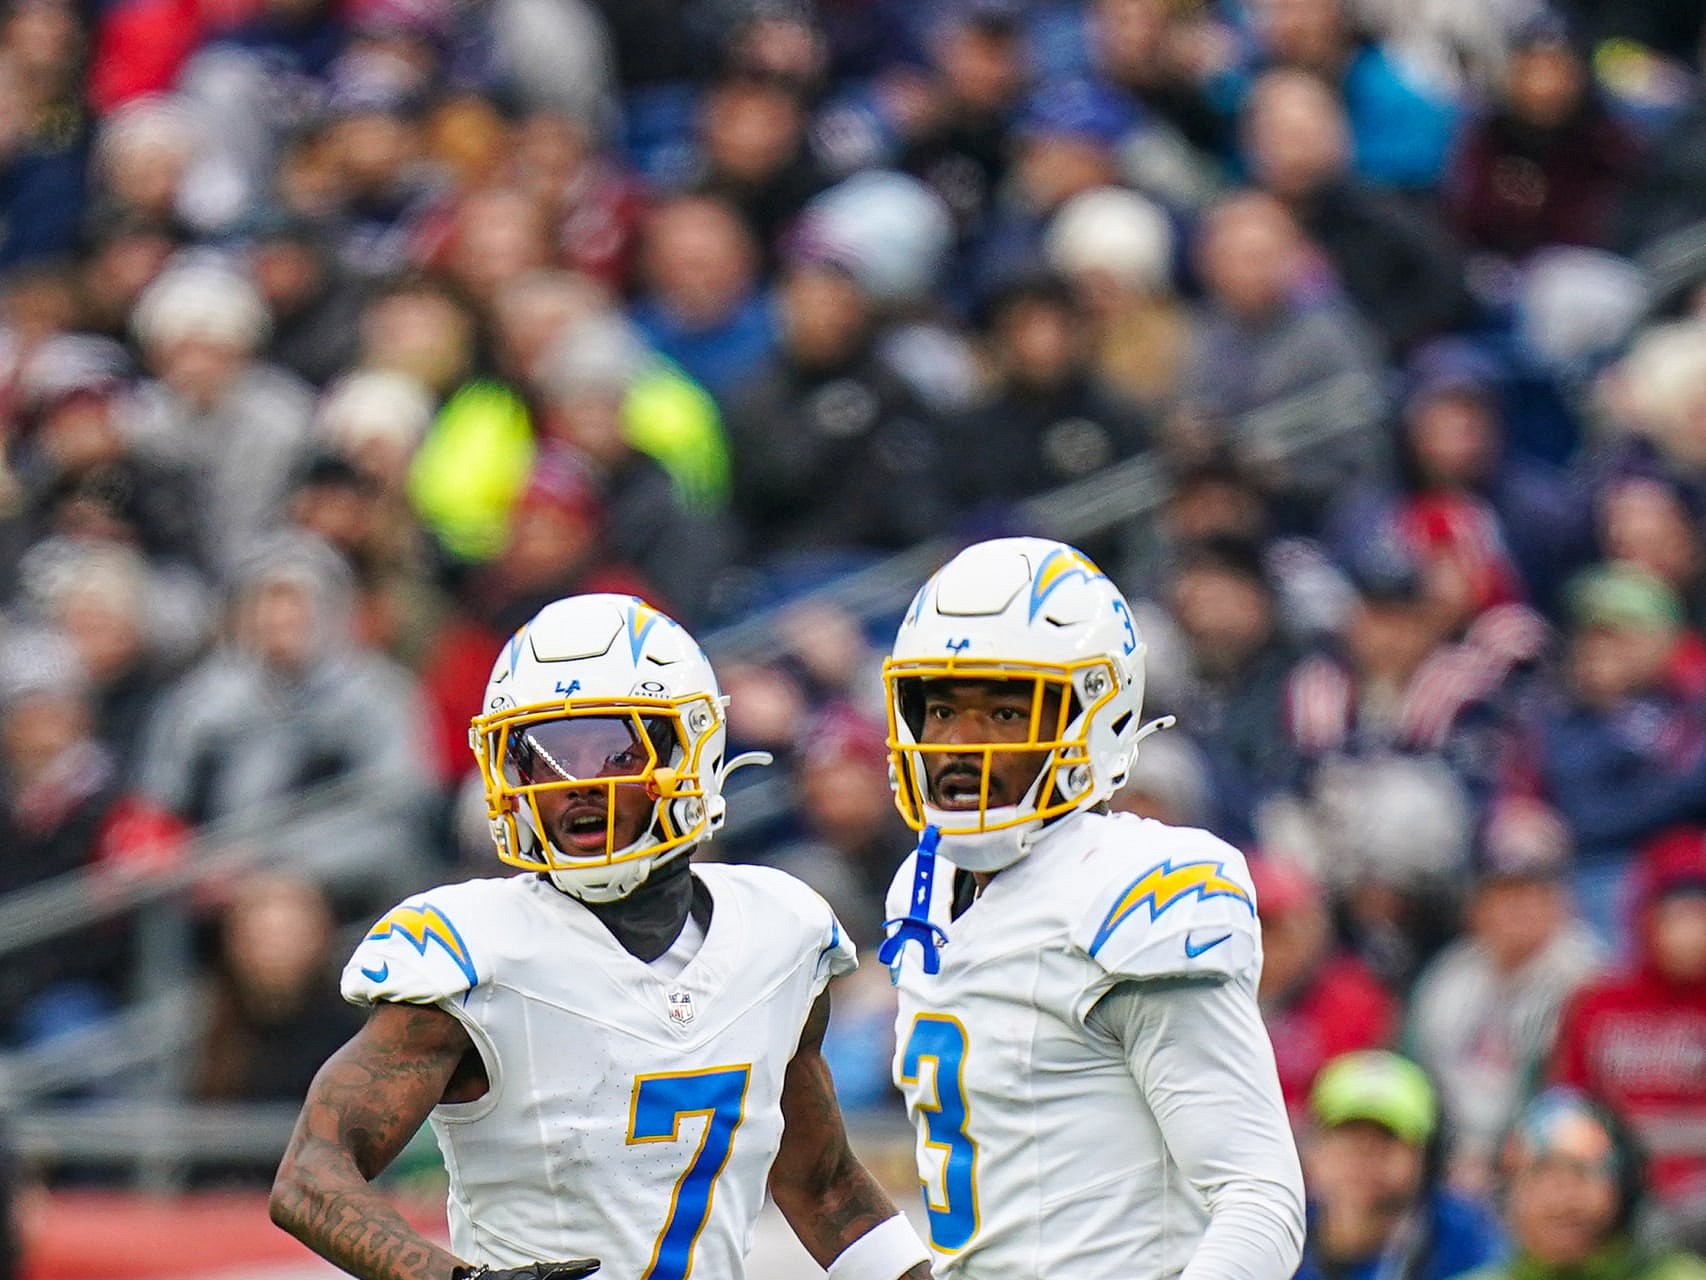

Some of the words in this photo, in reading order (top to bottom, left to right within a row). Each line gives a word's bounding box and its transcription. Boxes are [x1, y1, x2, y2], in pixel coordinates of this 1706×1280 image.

[1112, 600, 1136, 656] 3
[555, 680, 580, 698] LA
[901, 1012, 980, 1254] 3
